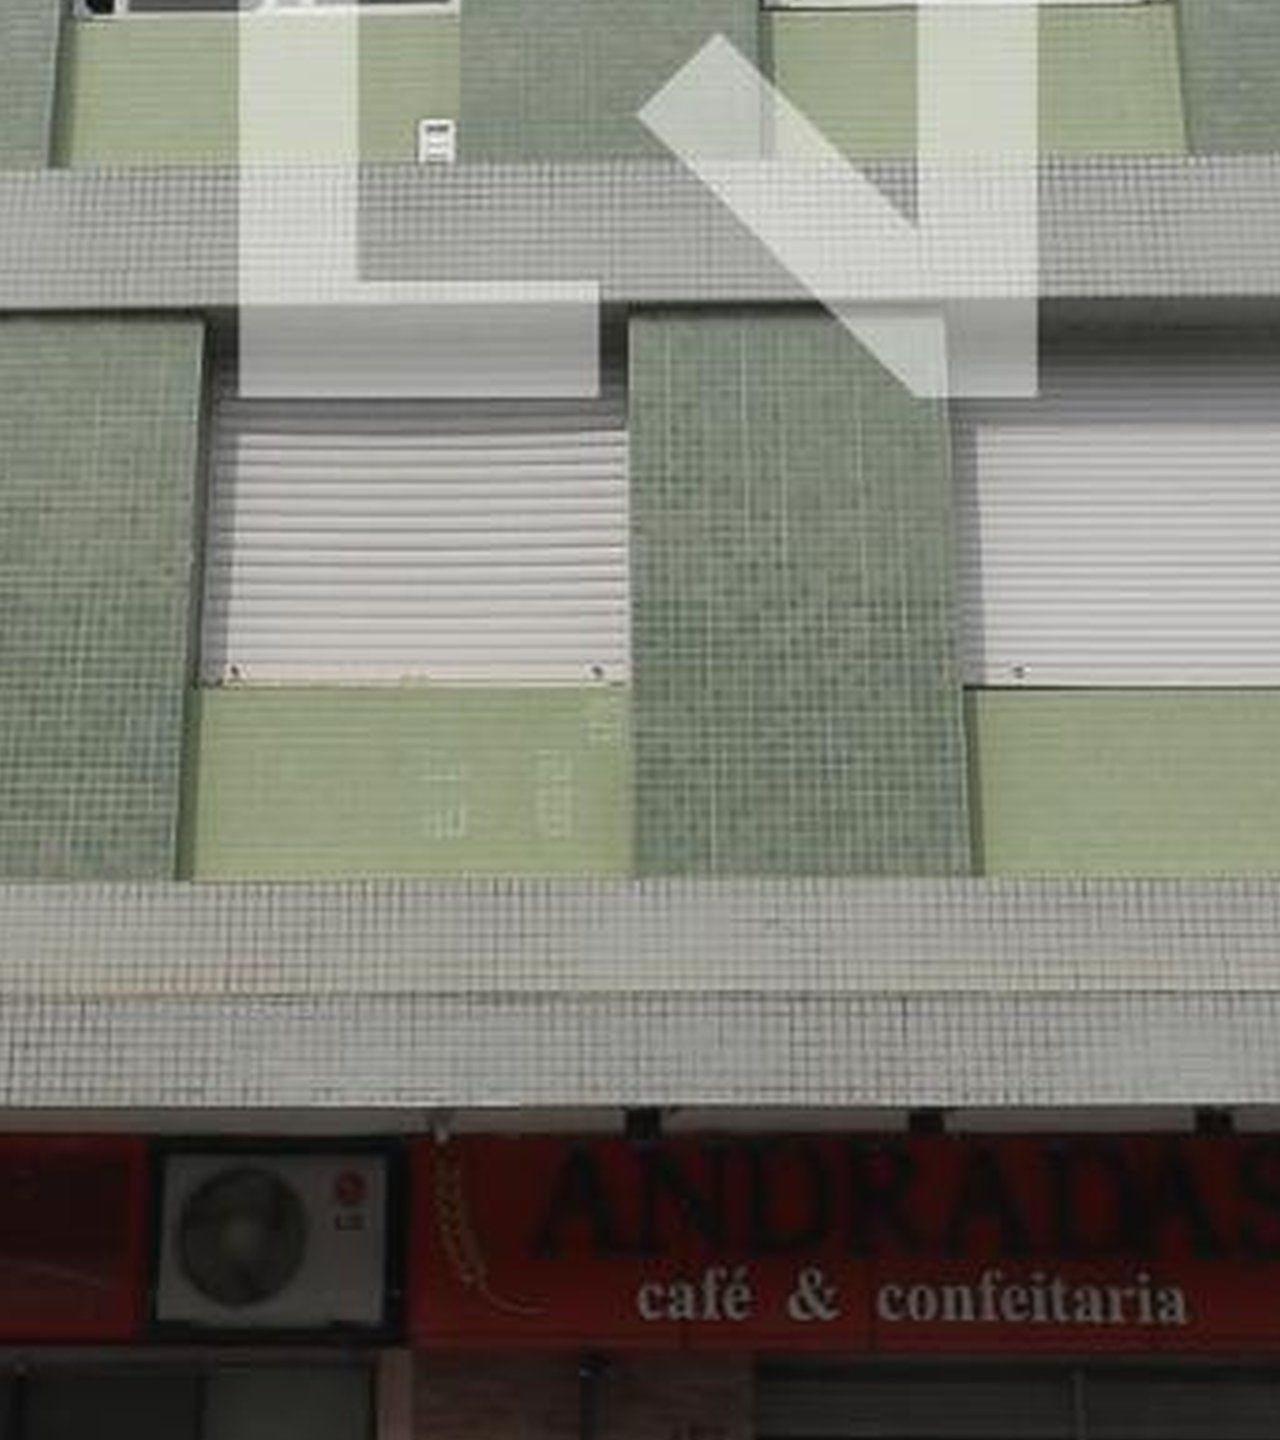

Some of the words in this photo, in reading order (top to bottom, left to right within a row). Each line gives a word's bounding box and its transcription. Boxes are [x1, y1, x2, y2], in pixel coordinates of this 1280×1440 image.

[634, 1269, 752, 1324] café
[787, 1268, 837, 1324] &
[875, 1272, 1188, 1326] confeitaria
